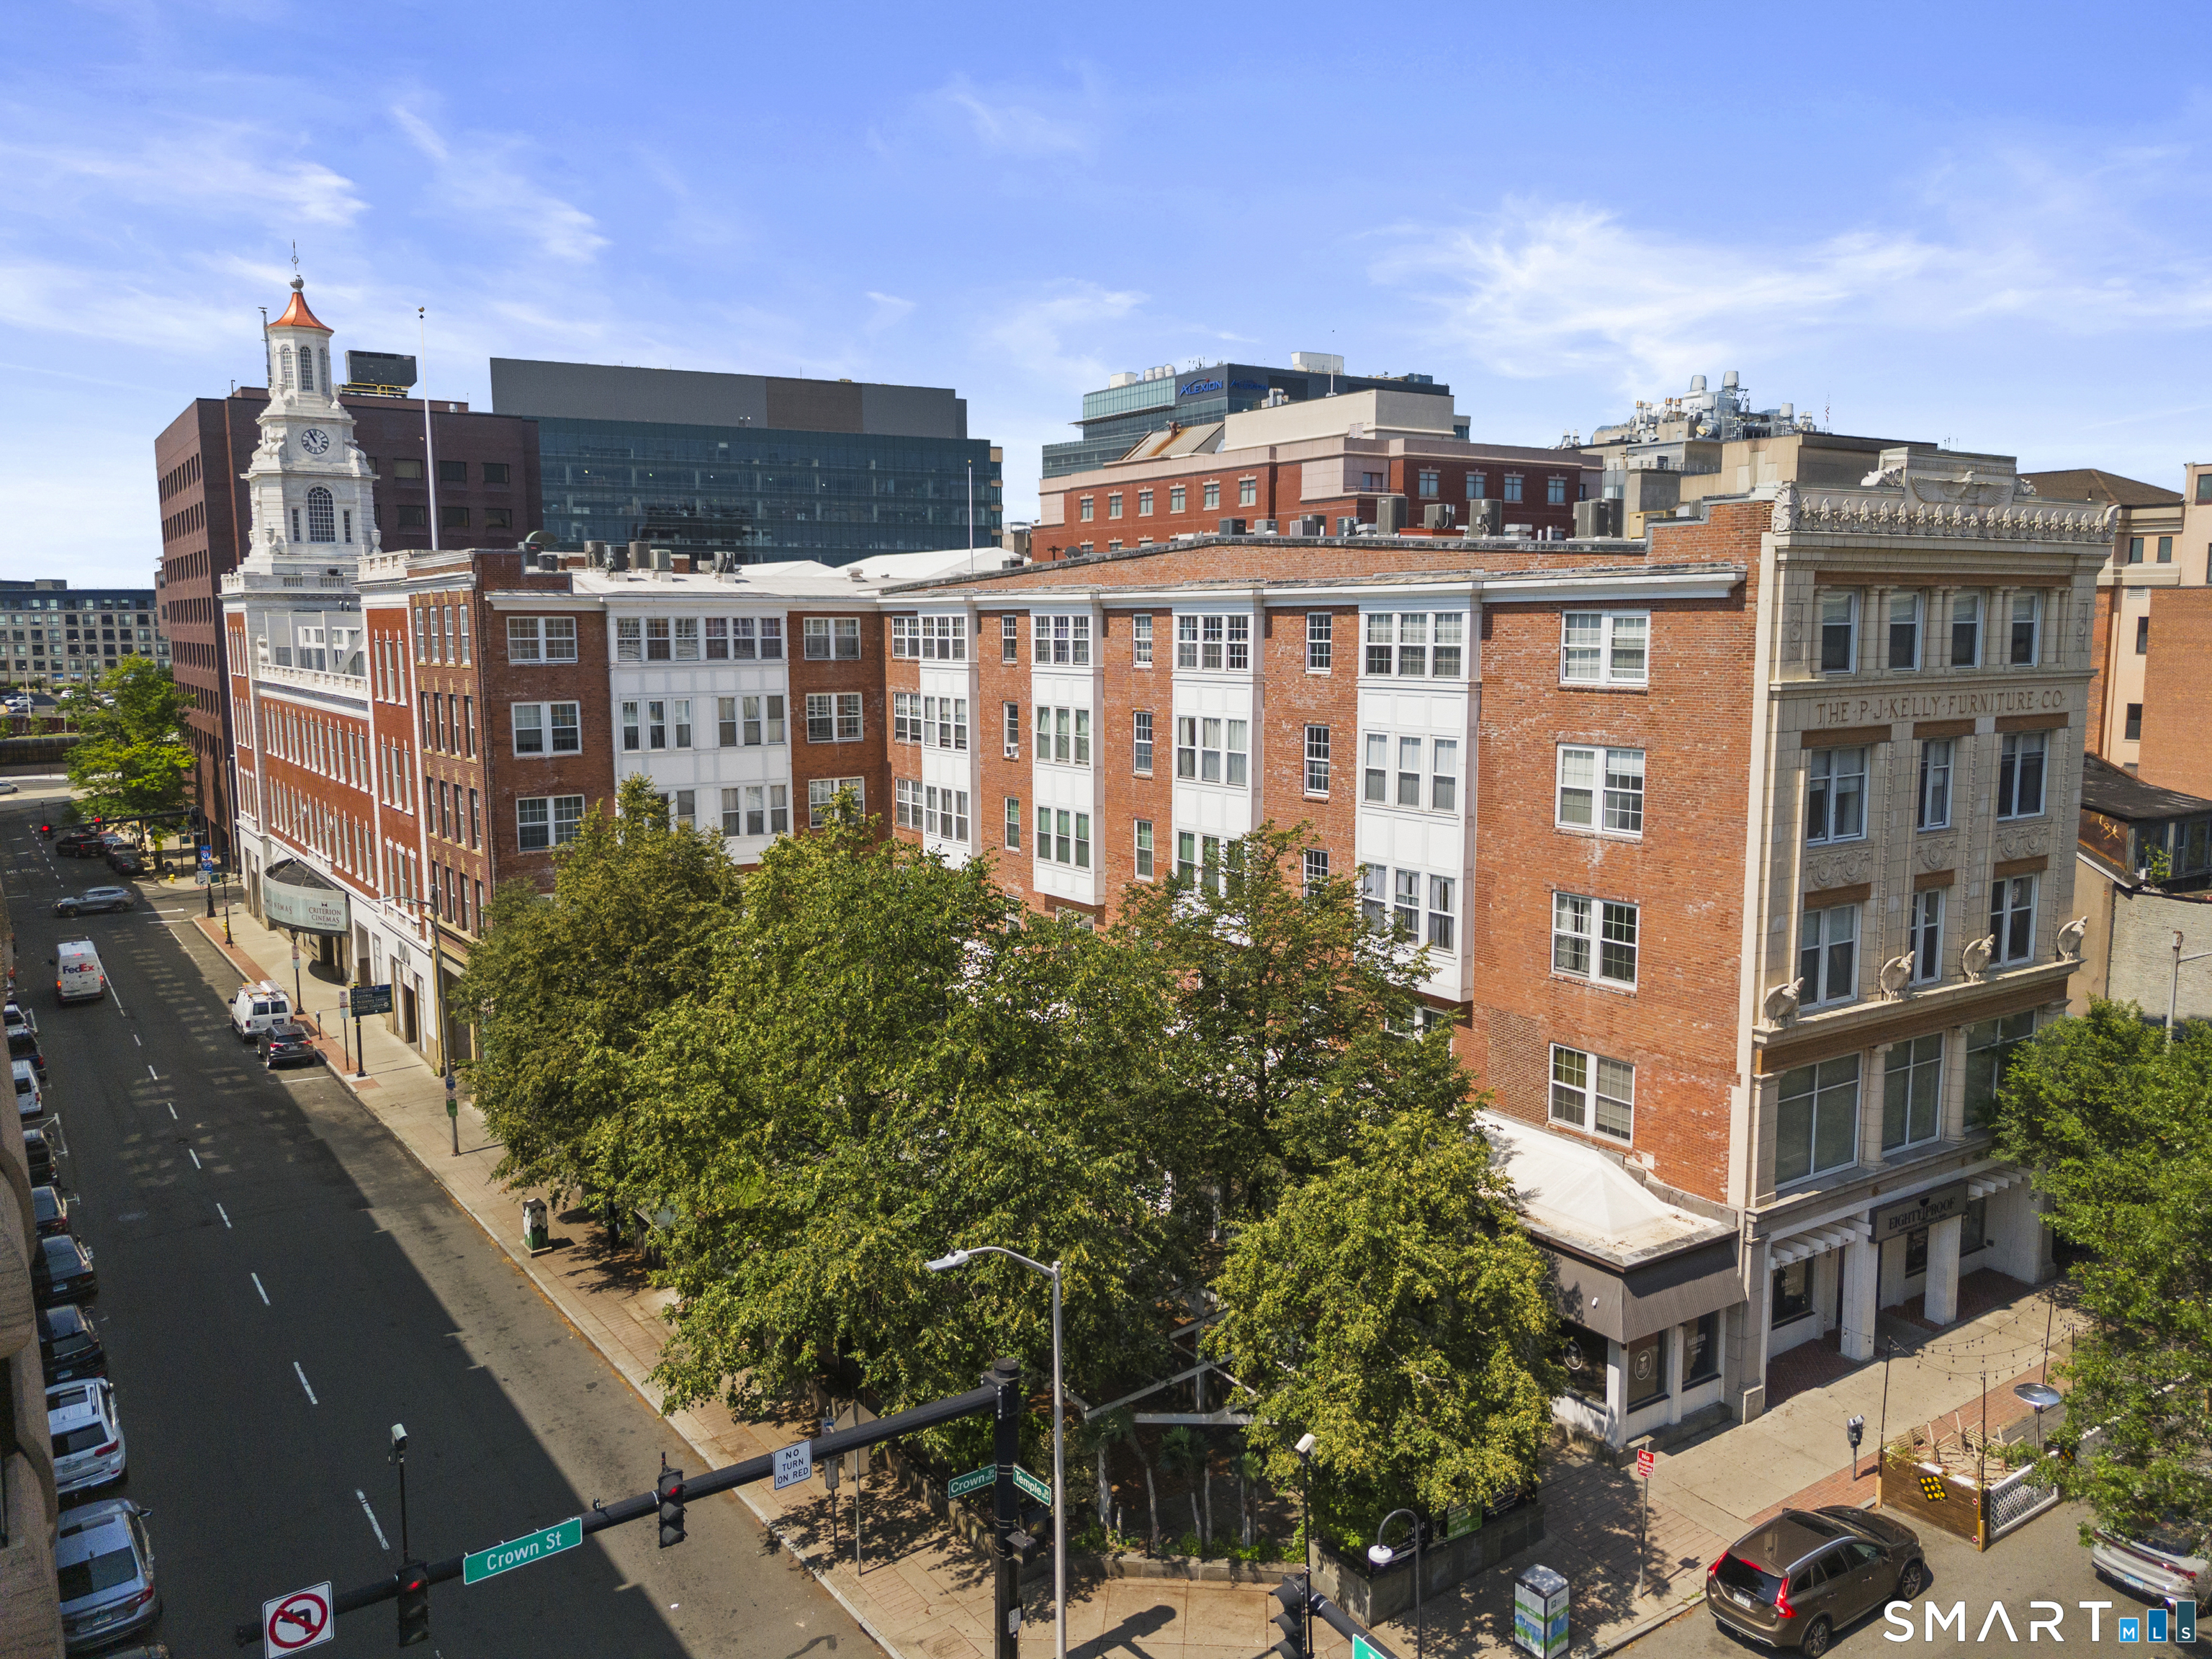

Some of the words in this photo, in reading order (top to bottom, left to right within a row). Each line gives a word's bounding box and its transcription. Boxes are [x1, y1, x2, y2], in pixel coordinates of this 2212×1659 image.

[1179, 380, 1223, 397] ALEXION
[1815, 701, 1849, 723] THE
[1948, 691, 2034, 714] FURNITURE
[308, 907, 342, 916] CRITERION
[311, 914, 340, 924] CINEMAS
[63, 963, 95, 974] FedEx
[1889, 1209, 1922, 1230] EIGHTY
[1925, 1197, 1956, 1217] PROOF
[786, 1449, 799, 1460] NO
[782, 1457, 804, 1471] TURN
[778, 1474, 788, 1483] ON
[793, 1467, 809, 1478] RED
[1015, 1470, 1042, 1496] Temple
[950, 1474, 985, 1493] Crown
[487, 1542, 539, 1570] Crown
[546, 1531, 562, 1550] St
